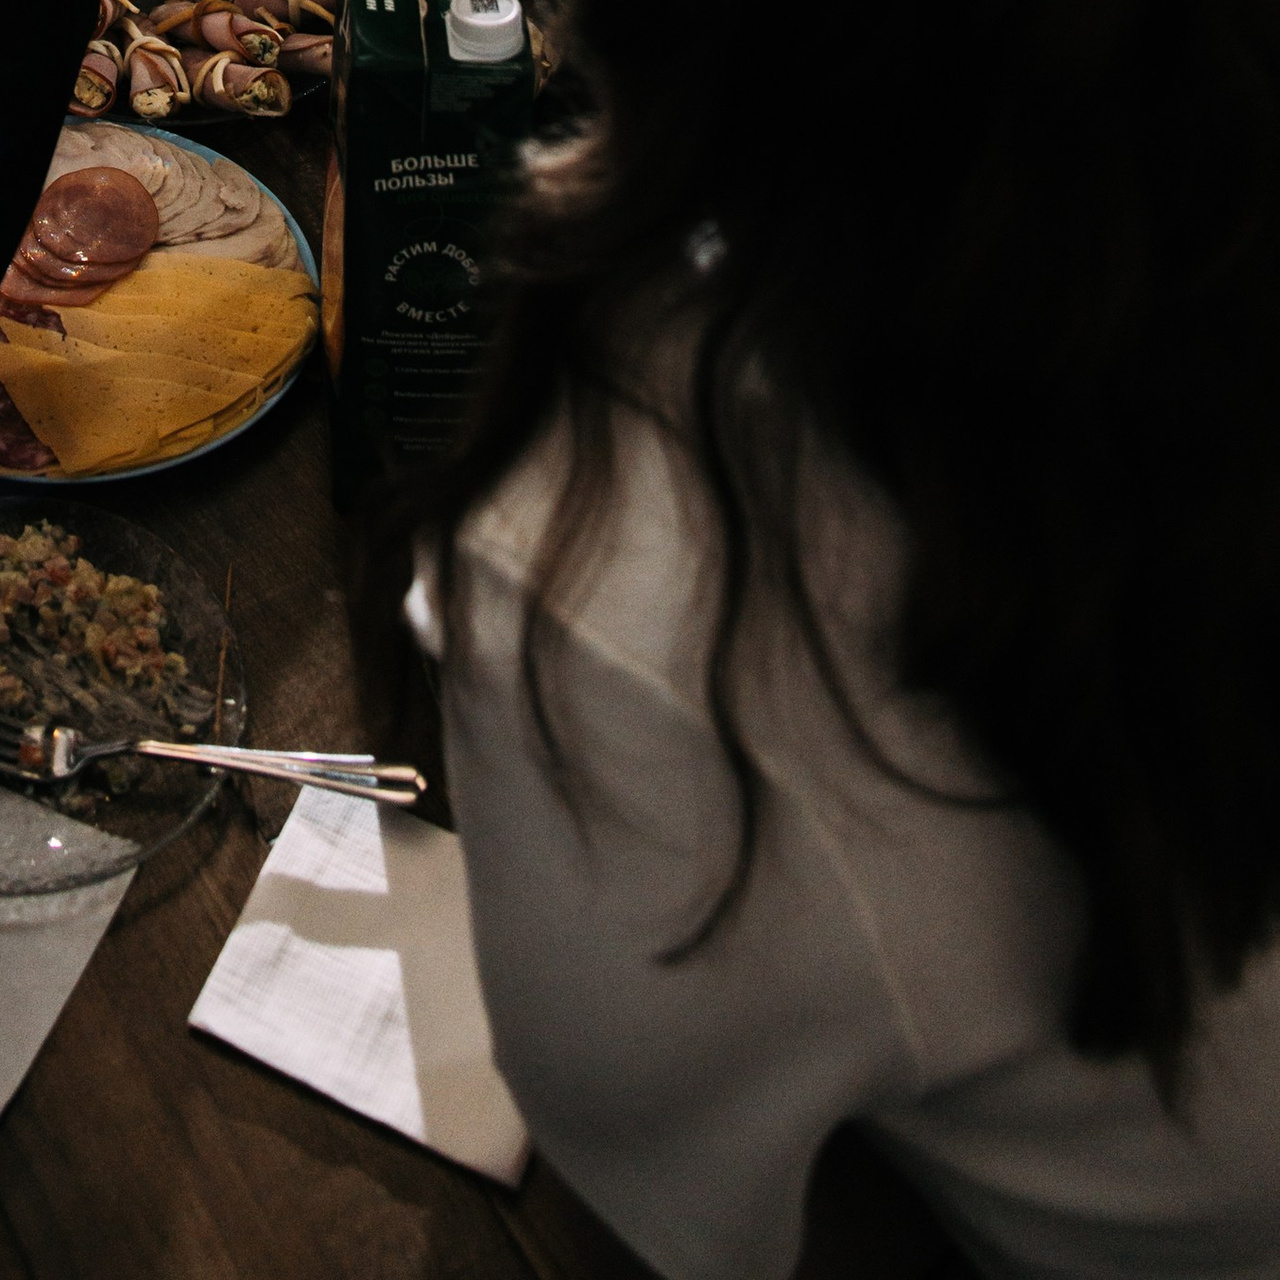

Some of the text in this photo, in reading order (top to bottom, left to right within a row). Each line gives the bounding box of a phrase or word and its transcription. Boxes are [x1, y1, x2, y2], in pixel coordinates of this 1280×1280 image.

[390, 152, 480, 175] БОЛЬШЕ
[373, 171, 455, 193] ПОЛЬЗЫ
[383, 240, 438, 283] РАСТИМ
[395, 300, 472, 324] ВМЕСТЕ
